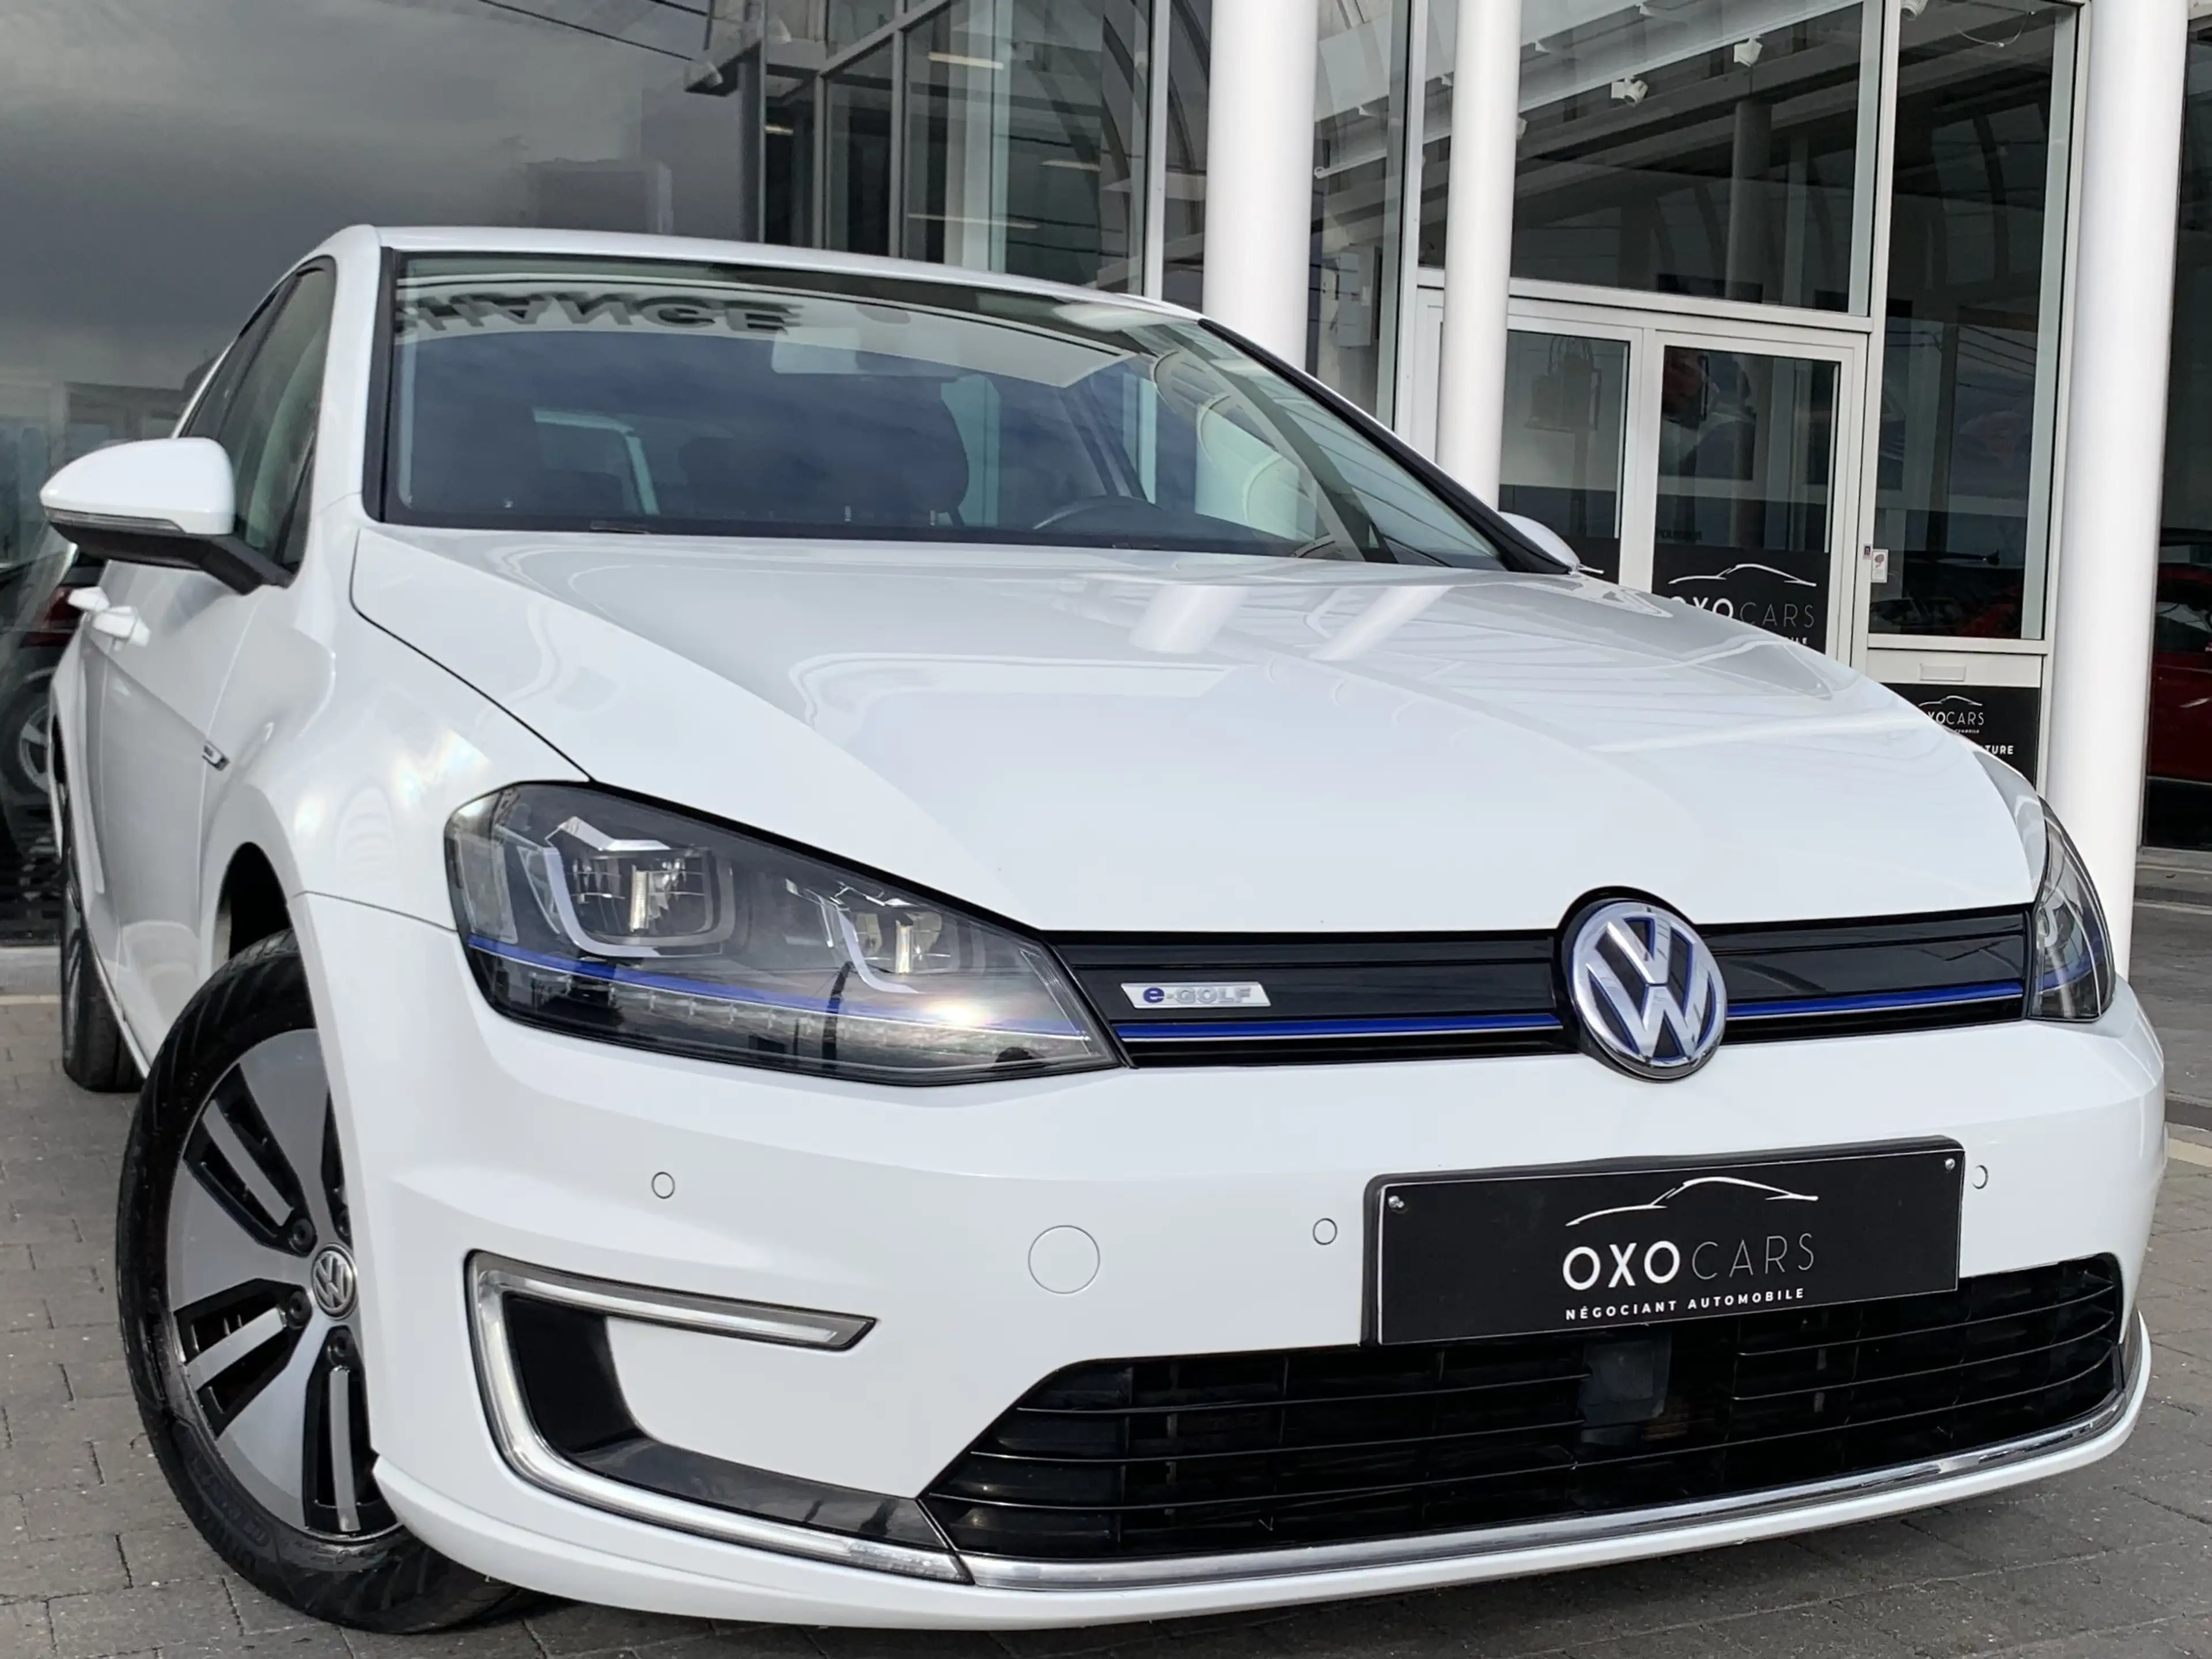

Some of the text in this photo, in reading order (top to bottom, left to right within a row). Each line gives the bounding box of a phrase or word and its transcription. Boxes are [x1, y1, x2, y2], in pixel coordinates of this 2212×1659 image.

[1142, 987, 1252, 1004] e-GOLF
[1565, 1287, 1805, 1321] NÉGOCIANT AUTOMOBILE
